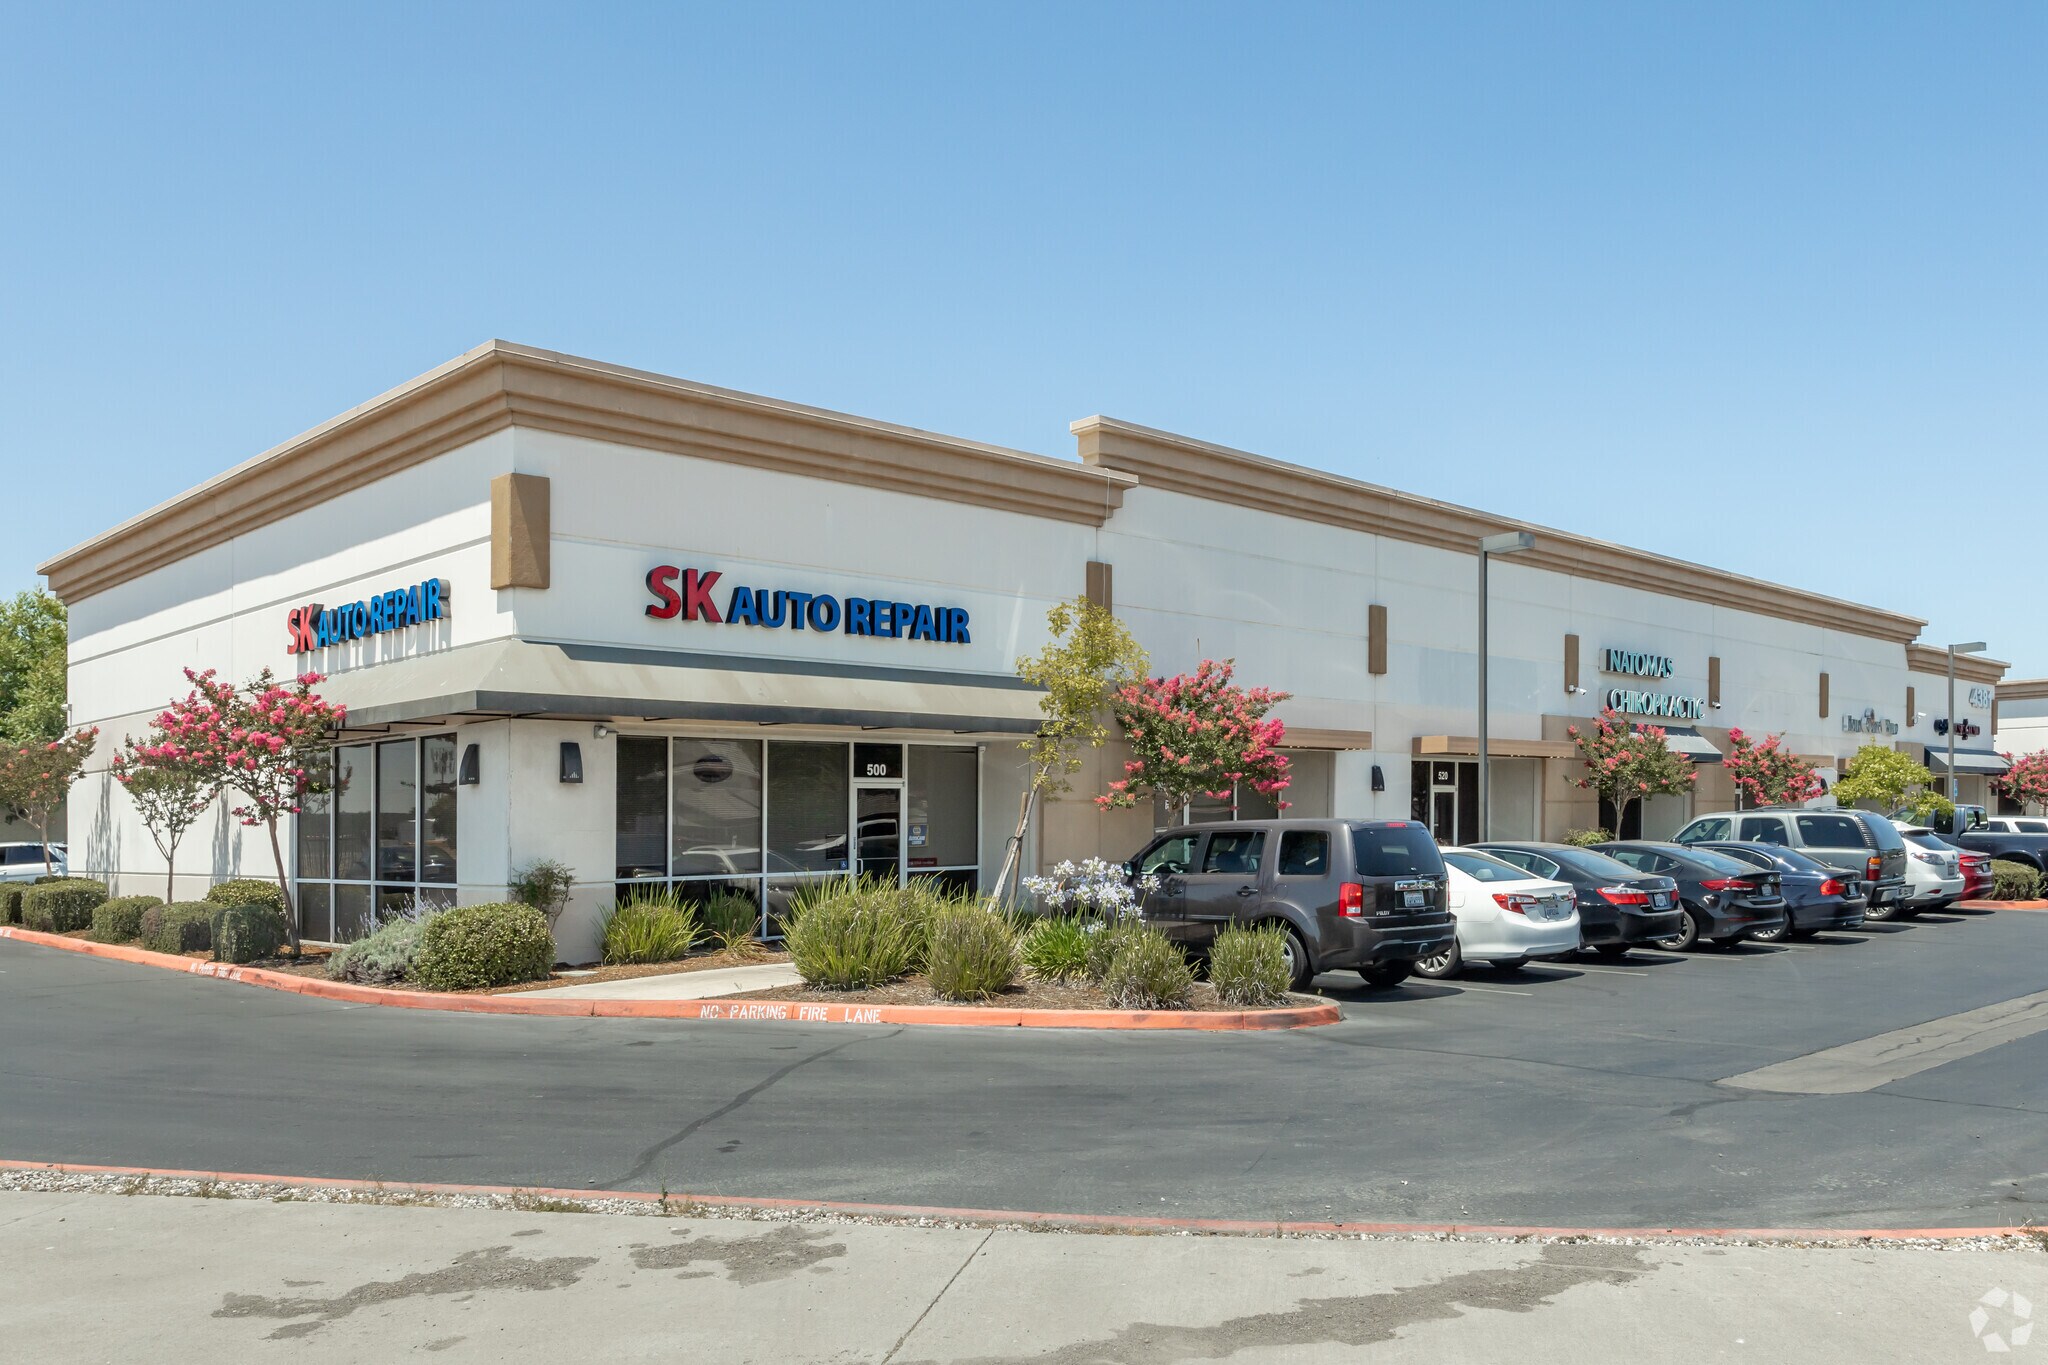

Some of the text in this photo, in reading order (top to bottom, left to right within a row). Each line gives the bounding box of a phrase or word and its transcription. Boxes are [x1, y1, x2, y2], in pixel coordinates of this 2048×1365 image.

[287, 578, 448, 655] SK AUTO REPAIR
[645, 565, 971, 644] SK AUTO REPAIR
[1607, 649, 1675, 679] NATOMAS
[1607, 688, 1706, 719] CHIROPRACTIC
[866, 763, 887, 776] 500
[1437, 771, 1449, 780] 520
[729, 1004, 787, 1020] PARKING
[799, 1006, 829, 1021] FIRE
[844, 1007, 882, 1023] LANE
